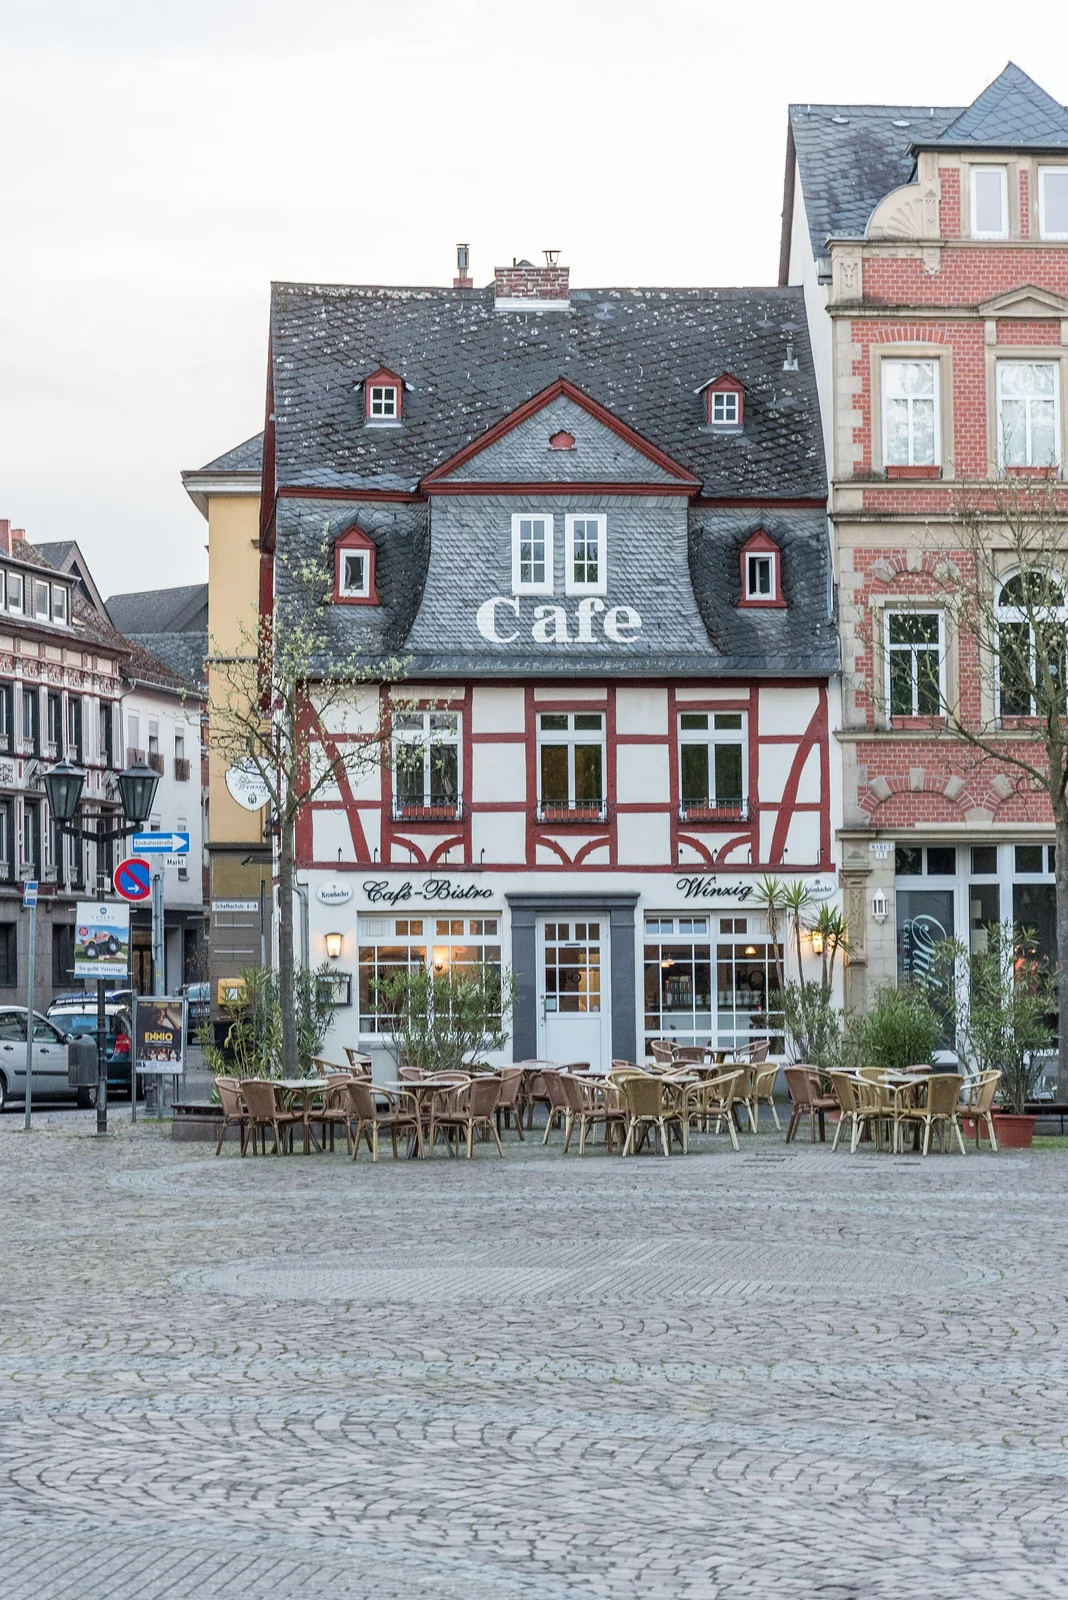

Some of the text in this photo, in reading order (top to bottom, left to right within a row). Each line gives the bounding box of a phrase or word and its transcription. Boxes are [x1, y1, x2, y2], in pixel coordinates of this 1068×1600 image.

[476, 596, 643, 644] Cafe
[321, 890, 349, 899] Krombacher
[363, 879, 494, 906] Café-Bistro
[676, 875, 753, 901] Winzig
[144, 1031, 173, 1041] ENNIO
